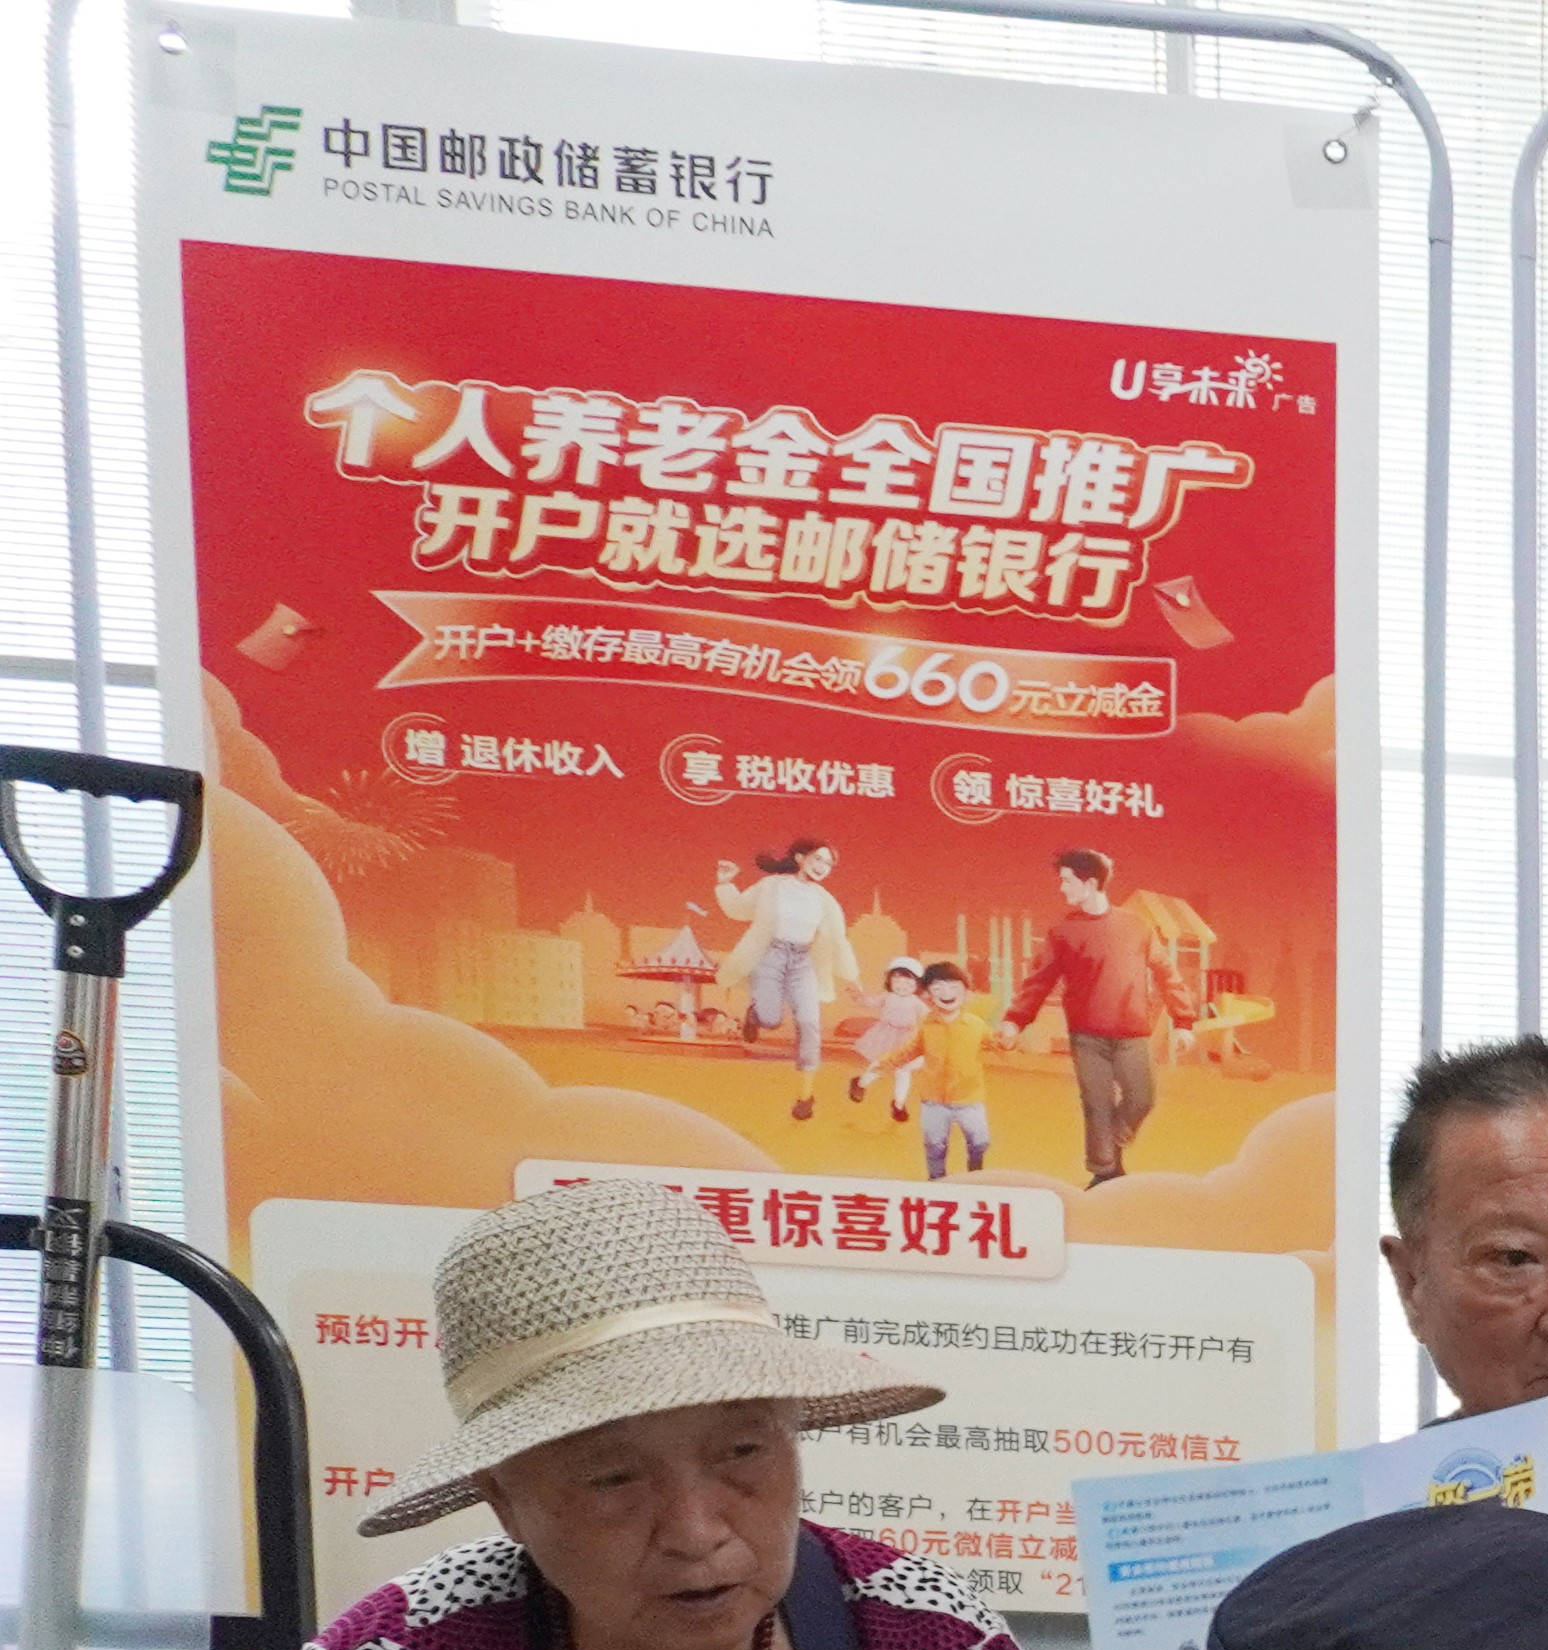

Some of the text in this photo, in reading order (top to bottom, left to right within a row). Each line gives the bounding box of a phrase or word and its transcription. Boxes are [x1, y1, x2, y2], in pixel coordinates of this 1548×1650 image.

[323, 116, 775, 206] 中国邮政储蓄银行
[323, 178, 776, 239] POSTAL SAVINGS BANK OF CHINA
[1110, 356, 1257, 410] U享未来
[1272, 392, 1317, 415] 广告
[309, 372, 1238, 530] 个人养老金全国推广
[418, 484, 1131, 610] 开户就选邮储银行
[434, 624, 1166, 721] 开户+缴存最高有机会领660元立减金
[404, 729, 1165, 819] 增 退休收入 享 税收优惠 领 惊喜好礼
[553, 1177, 1028, 1260] 重惊喜好礼
[315, 1312, 441, 1349] 预约开
[773, 1313, 1255, 1365] 推广前完成预约且成功在我行开户有
